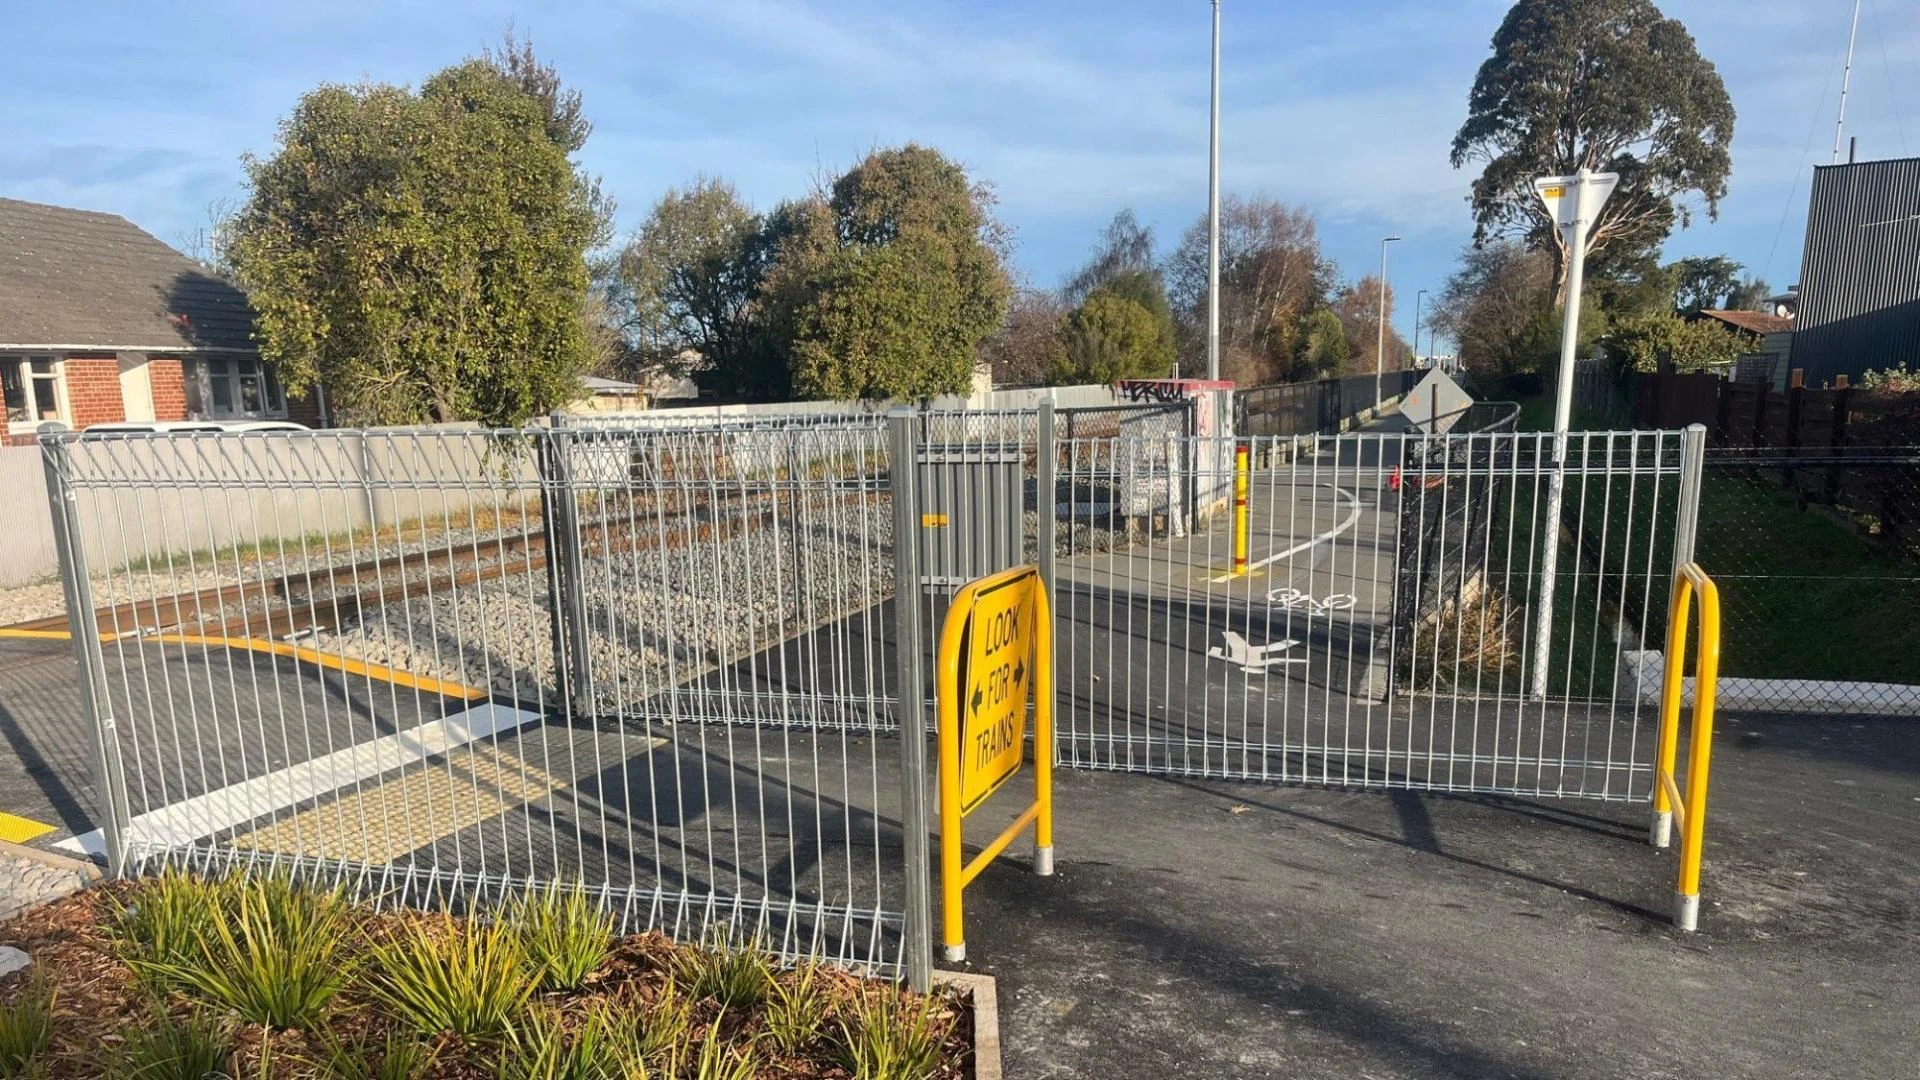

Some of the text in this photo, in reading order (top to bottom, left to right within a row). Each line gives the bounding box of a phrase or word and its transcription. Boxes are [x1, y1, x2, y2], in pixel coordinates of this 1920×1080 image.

[985, 604, 1021, 657] LOOK
[987, 663, 1010, 709] FOR
[976, 711, 1015, 772] TRAINS
